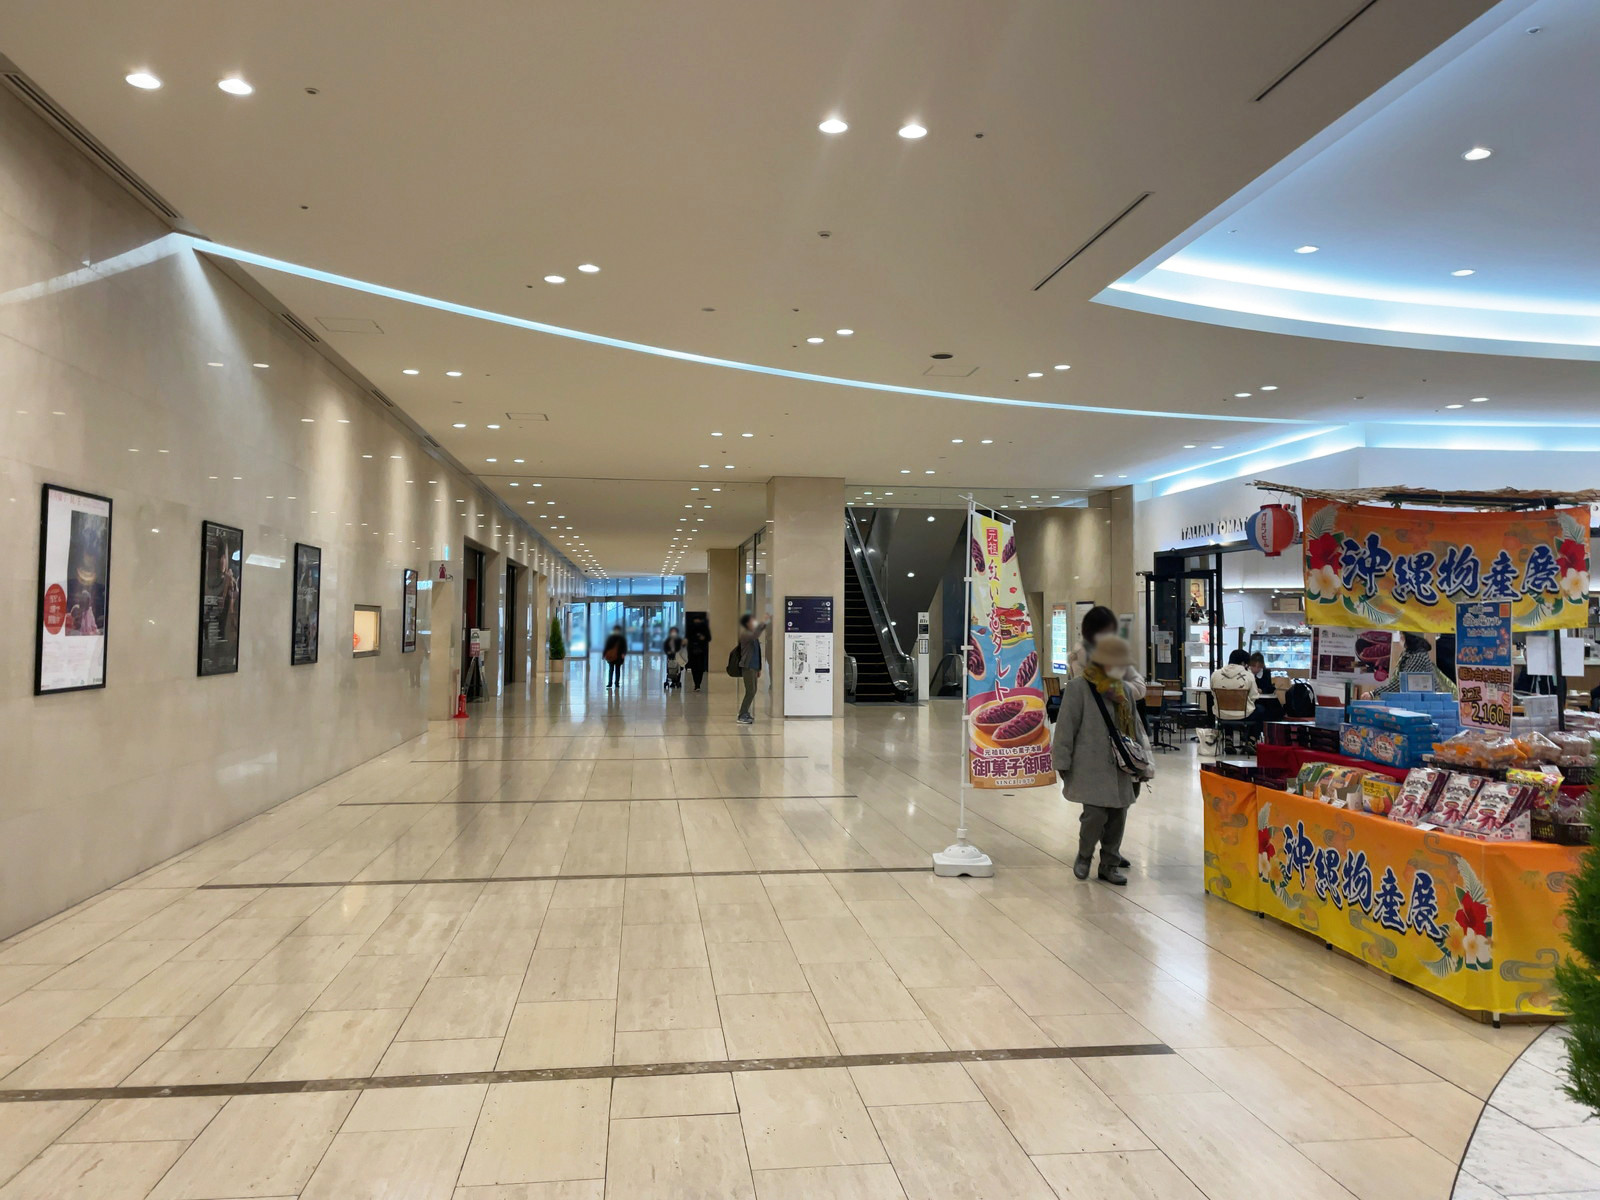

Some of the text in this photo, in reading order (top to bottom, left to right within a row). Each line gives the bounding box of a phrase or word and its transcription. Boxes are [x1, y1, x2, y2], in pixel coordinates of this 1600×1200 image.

[986, 528, 999, 556] 元祖
[1181, 516, 1248, 541] ITALIAN TOMAT
[1340, 532, 1561, 604] 沖縄物産展
[972, 754, 1052, 777] 御菓子御殿
[1283, 820, 1443, 938] 沖縄物産展
